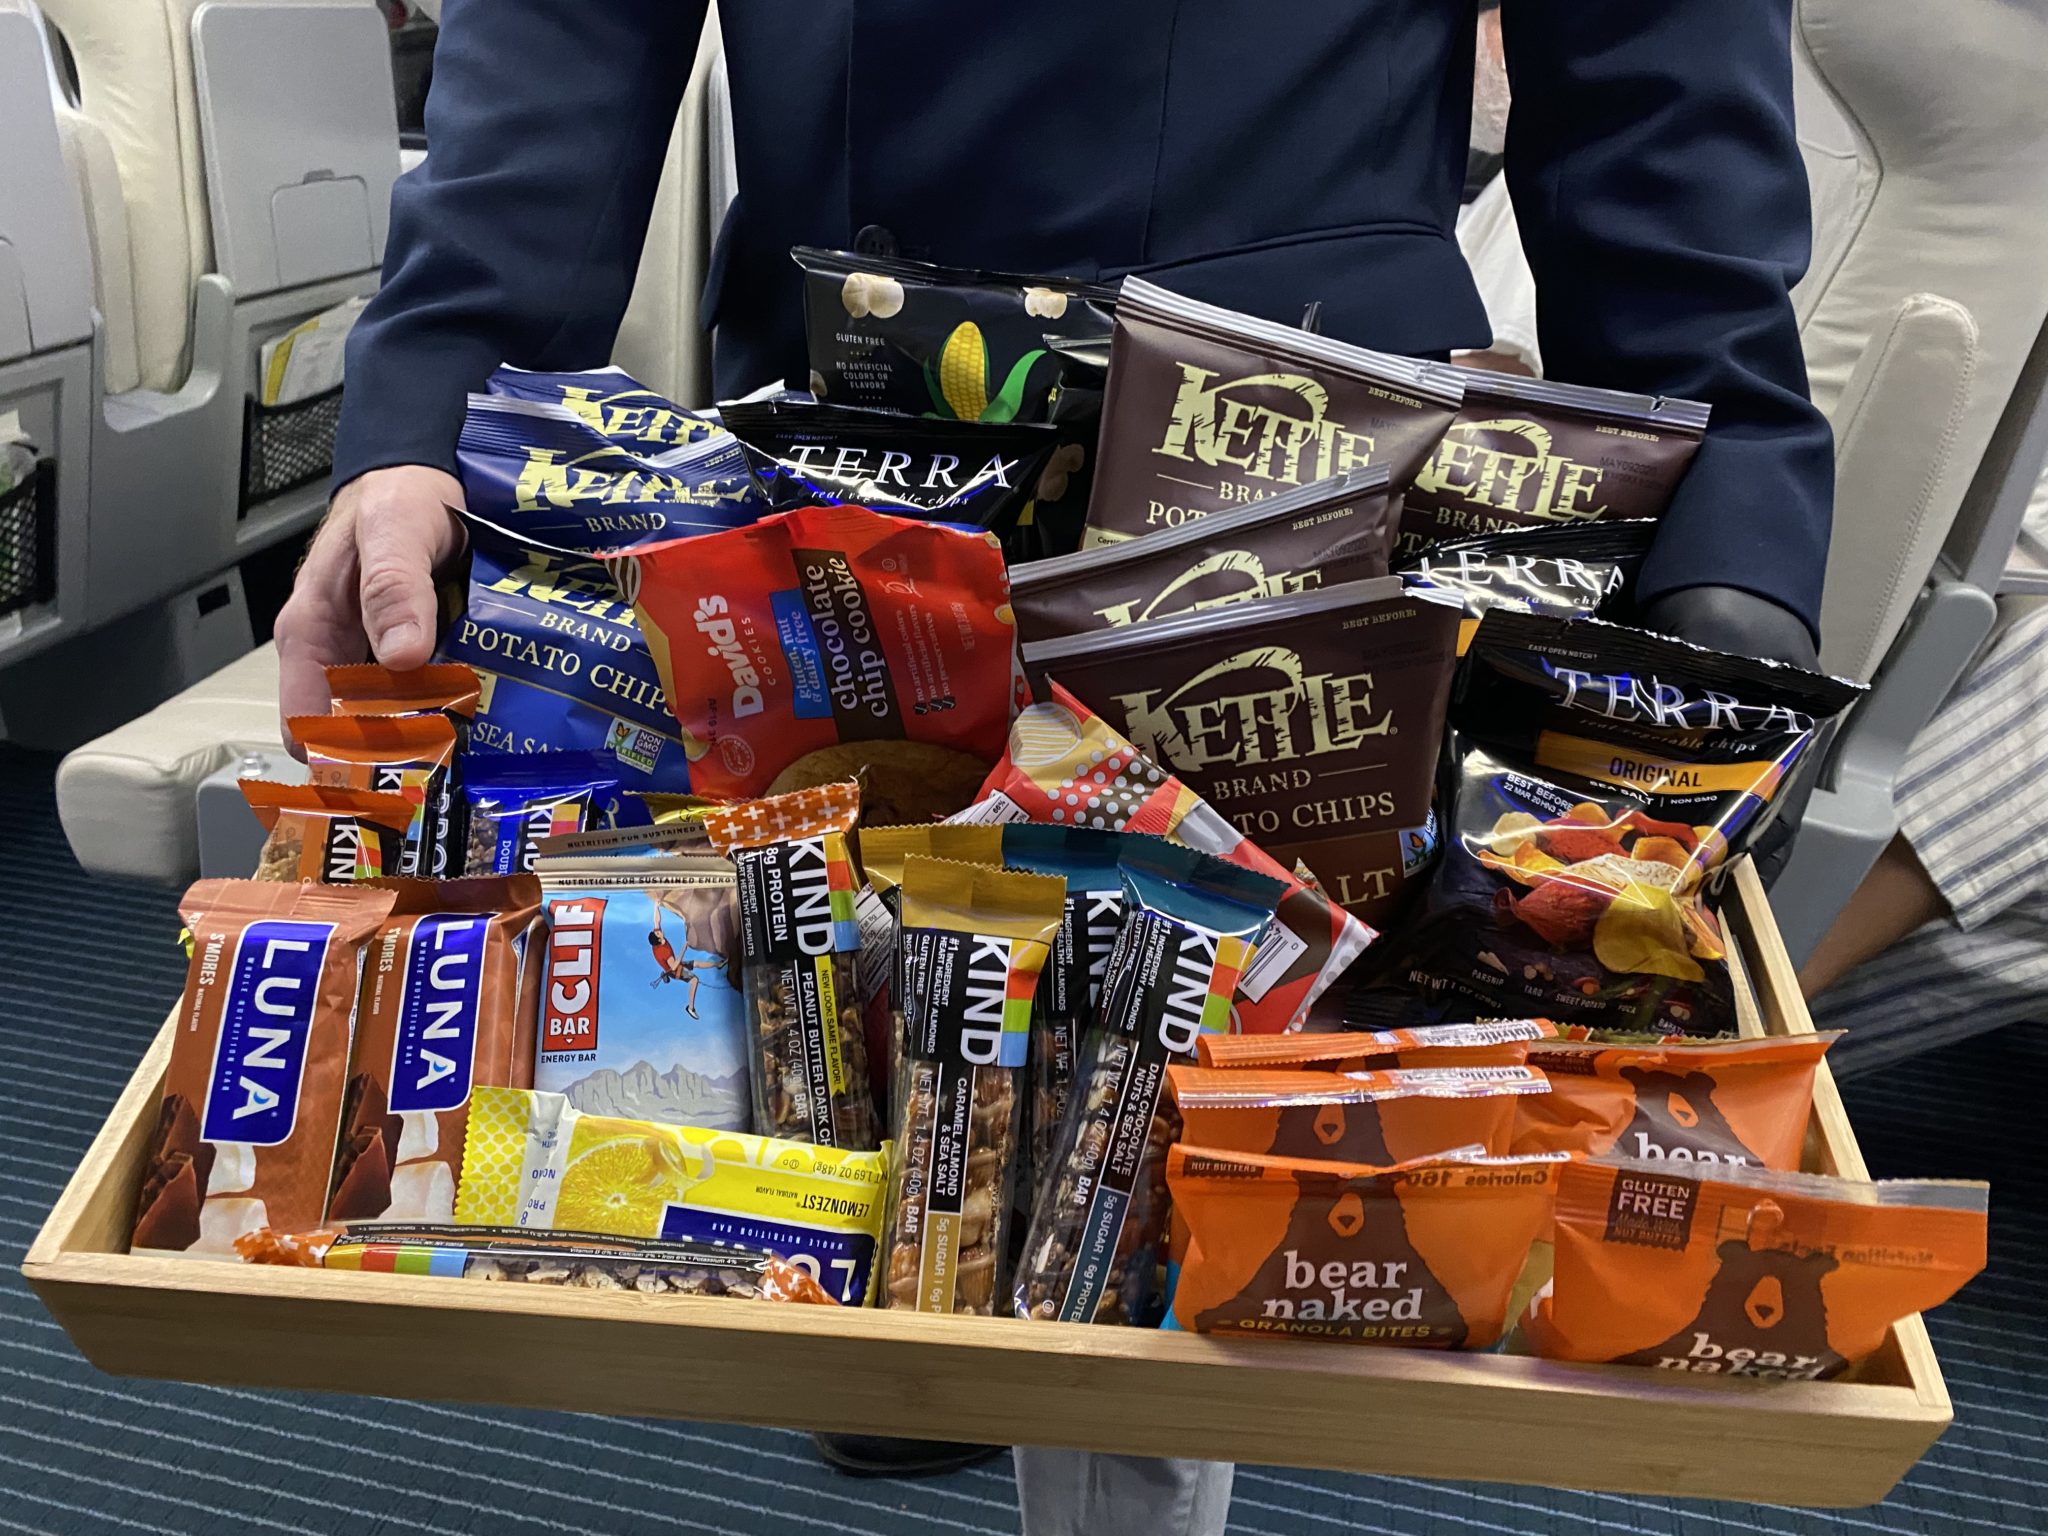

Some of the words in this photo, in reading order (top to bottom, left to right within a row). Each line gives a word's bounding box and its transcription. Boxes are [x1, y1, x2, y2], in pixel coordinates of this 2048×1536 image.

[836, 332, 862, 345] GLUTEN
[865, 335, 885, 346] FREE
[836, 361, 847, 371] NO
[849, 362, 893, 373] ARTIFICIAL
[843, 372, 875, 381] COLORS
[850, 381, 886, 390] FLAVORS
[557, 384, 727, 445] KETT
[1152, 361, 1375, 485] KETTLE
[790, 445, 1014, 489] TERRA
[811, 489, 844, 499] real
[585, 512, 667, 533] BRAND
[1292, 517, 1315, 531] BEST
[827, 557, 870, 644] cookie
[539, 612, 631, 652] BRAND
[778, 618, 794, 645] nut
[1342, 617, 1369, 629] BEST
[1372, 609, 1417, 624] BEFORE:
[459, 620, 581, 676] POTATO
[741, 617, 776, 686] COOKIES
[806, 563, 857, 710] chocolate
[1528, 644, 1548, 653] EASY
[1548, 646, 1567, 656] OPEN
[1568, 649, 1594, 659] NOTCH
[693, 595, 764, 718] David's
[802, 649, 821, 690] dairy
[857, 651, 889, 717] chip
[1110, 645, 1394, 773] KETTLE
[1554, 667, 1805, 734] TERRA
[609, 743, 653, 766] VRIFIED
[637, 740, 659, 753] GMO
[640, 731, 661, 746] NON
[1710, 738, 1758, 754] chips
[1213, 769, 1311, 801] BRAND
[1609, 757, 1703, 788] ORIGINAL
[1503, 783, 1514, 791] 22
[1514, 786, 1531, 801] MAR
[1506, 773, 1531, 790] BEST
[1536, 784, 1574, 812] BEFORE
[1590, 780, 1617, 793] SEA
[1620, 788, 1655, 806] SALT
[1670, 796, 1693, 805] NON
[1695, 795, 1718, 803] GMO
[1292, 792, 1396, 828] CHIPS
[643, 826, 696, 839] SUSTAINED
[329, 824, 360, 880] KIN
[764, 847, 779, 864] 8g
[558, 878, 613, 886] NUTRITION
[616, 877, 637, 885] FOR
[639, 876, 695, 885] SUSTAINED
[698, 876, 736, 884] ENERGY
[746, 864, 758, 913] INGREDIENT
[787, 835, 834, 956] KIND
[740, 877, 750, 915] HEALTHY
[745, 917, 755, 956] PEANUTS
[768, 868, 788, 941] PROTEIN
[949, 938, 960, 952] #1
[1064, 913, 1073, 965] INGREDIENT
[1133, 912, 1145, 947] GLUTEN
[1150, 917, 1161, 946] HEART
[199, 932, 226, 986] S'MORES
[379, 927, 402, 972] S'MORES
[416, 941, 427, 973] WHOLE
[551, 903, 595, 1015] CLIF
[919, 934, 930, 967] GLUTEN
[937, 937, 948, 963] HEART
[1058, 926, 1066, 966] HEALTHY
[1086, 890, 1123, 1008] KIN
[1126, 947, 1137, 971] FREE
[1148, 936, 1166, 988] INGREDIENT
[240, 957, 255, 992] WHOLE
[781, 969, 795, 991] NET
[821, 969, 830, 989] NEW
[916, 969, 925, 995] FREE
[941, 953, 955, 1007] INGREDIENT
[1139, 947, 1154, 985] HEALTHY
[1409, 970, 1428, 985] NET
[1430, 977, 1449, 991] WT
[1471, 969, 1504, 985] PARSNIP
[802, 972, 818, 1026] PEANUT
[932, 964, 945, 1006] HEALTHY
[960, 934, 1012, 1065] KIND
[1058, 967, 1067, 1012] ALMONDS
[1158, 932, 1219, 1053] KIND
[1524, 984, 1543, 998] TARO
[408, 981, 422, 1039] NUTRITION
[416, 920, 475, 1090] LUNA
[1126, 988, 1144, 1031] ALMONDS
[1555, 993, 1579, 1006] SWEET
[1580, 995, 1606, 1010] POTATO
[227, 1000, 246, 1062] NUTRITION
[231, 939, 311, 1121] LUNA
[550, 1017, 590, 1036] BAR
[826, 1017, 837, 1044] SAME
[927, 1008, 938, 1053] ALMONDS
[1054, 1026, 1067, 1050] NET
[541, 1054, 576, 1064] ENERGY
[578, 1053, 597, 1063] BAR
[788, 1039, 802, 1056] OZ
[808, 1028, 824, 1083] BUTTER
[829, 1045, 841, 1084] FLAVOR!
[919, 1068, 933, 1094] NET
[1132, 1068, 1146, 1102] NUTS
[1141, 1063, 1159, 1103] DARK
[794, 1092, 808, 1119] BAR
[815, 1087, 829, 1126] DARK
[953, 1078, 968, 1137] CARAMEL
[941, 1125, 951, 1134] &
[1121, 1112, 1134, 1136] SEA
[910, 1148, 924, 1165] OZ
[938, 1136, 950, 1158] SEA
[1110, 1136, 1127, 1174] SALT
[1122, 1104, 1150, 1177] CHOCOLATE
[1634, 1132, 1747, 1169] bear
[812, 1161, 837, 1176] (48g)
[839, 1166, 852, 1179] OZ
[854, 1169, 872, 1183] 1.69
[935, 1160, 947, 1196] SALT
[947, 1140, 962, 1196] ALMOND
[1074, 1175, 1092, 1206] BAR
[1103, 1195, 1117, 1209] 5g
[1622, 1179, 1690, 1199] GLUTEN
[800, 1193, 870, 1218] LEMONZEST
[904, 1206, 919, 1234] BAR
[1617, 1192, 1687, 1220] FREE
[741, 1227, 800, 1244] NUTRITION
[936, 1217, 949, 1232] 5g
[1093, 1210, 1113, 1254] SUGAR
[808, 1237, 843, 1250] WHOLE
[934, 1232, 948, 1277] SUGAR
[693, 1256, 726, 1265] Potassium
[1084, 1264, 1098, 1279] 6g
[1284, 1249, 1408, 1290] bear
[929, 1286, 944, 1301] 6g
[1069, 1282, 1092, 1324] PROTEI
[1260, 1289, 1424, 1322] naked
[1239, 1319, 1353, 1338] GRANOLA
[1362, 1321, 1431, 1338] BITES
[1688, 1332, 1818, 1368] bear
